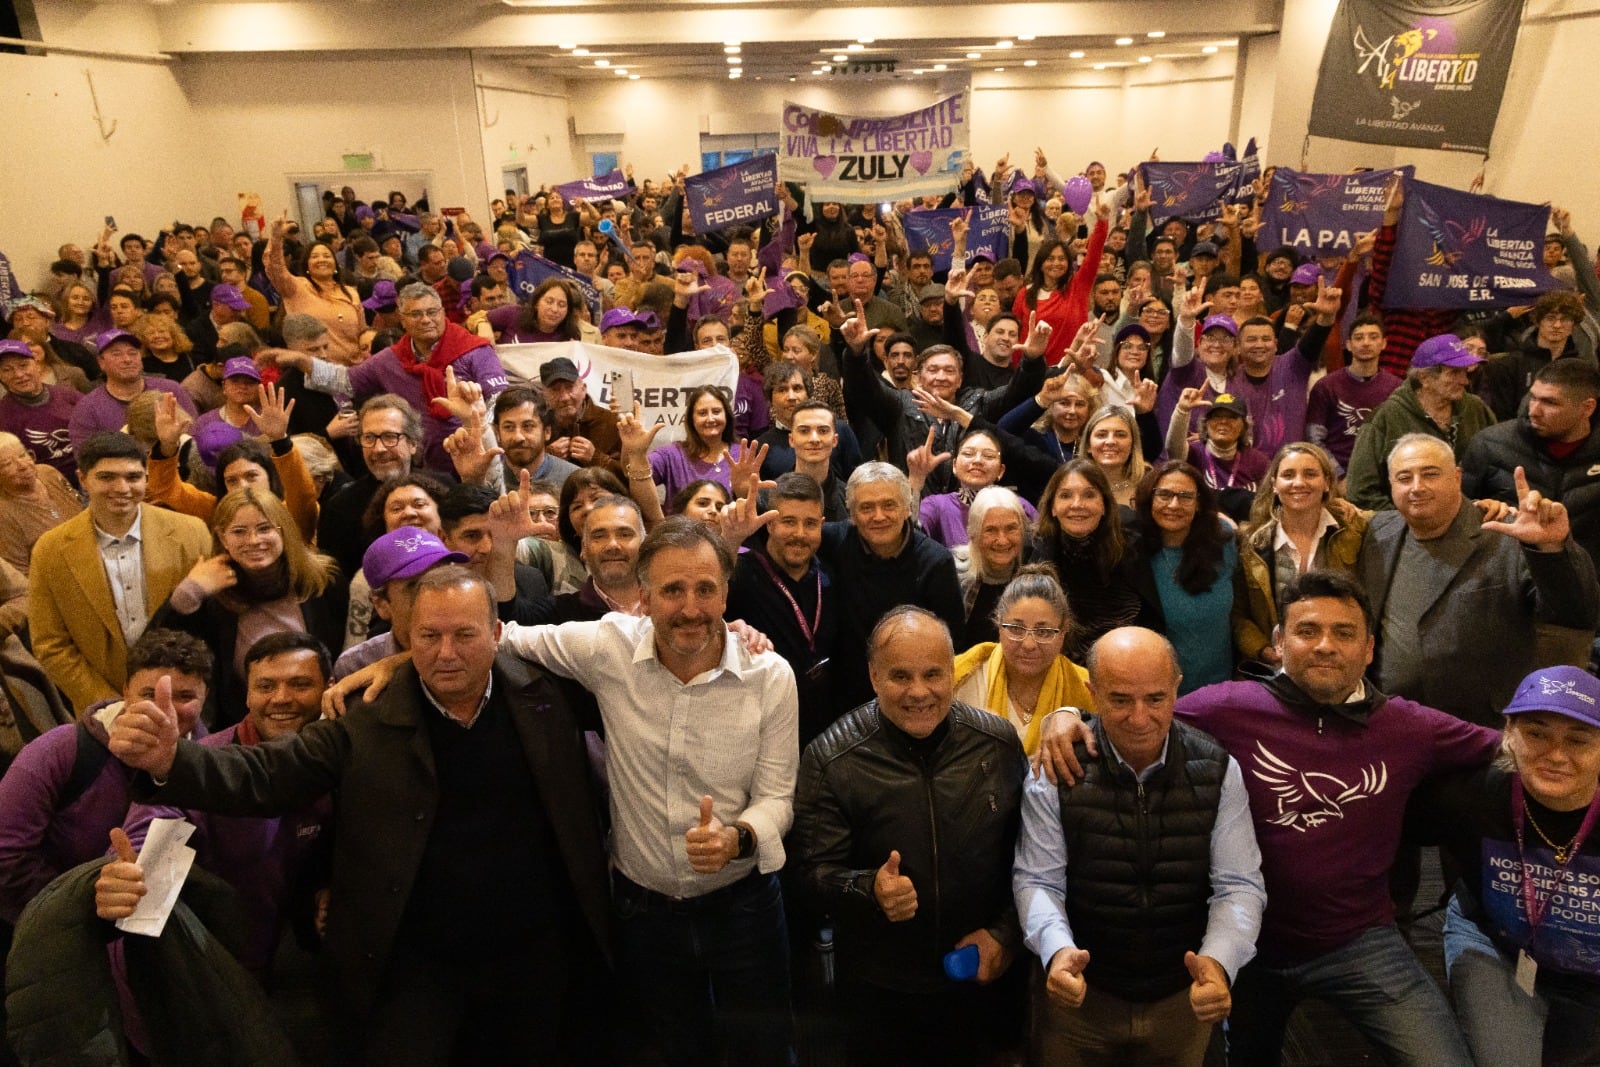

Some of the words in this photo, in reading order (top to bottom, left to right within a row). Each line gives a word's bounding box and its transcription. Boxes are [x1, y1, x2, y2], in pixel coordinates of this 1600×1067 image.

[1368, 119, 1409, 131] LIBERTAD
[1409, 122, 1446, 132] AVANZA
[787, 135, 819, 158] VIVA
[863, 126, 953, 152] LIBERTAD
[838, 154, 910, 181] ZULY
[1346, 177, 1359, 185] LA
[1343, 186, 1386, 195] LIBERT
[705, 200, 773, 226] FEDERAL
[1342, 203, 1370, 211] ENTRE
[1372, 204, 1387, 212] RIO
[1282, 227, 1311, 248] LA
[1486, 227, 1498, 238] LA
[1486, 238, 1535, 251] LIBERTAD
[1419, 272, 1441, 287] SAN
[1446, 274, 1469, 288] JOSE
[1473, 275, 1489, 288] DE
[1469, 289, 1495, 301] E.R.
[602, 373, 612, 385] L
[599, 385, 734, 408] LBERTD
[655, 413, 687, 426] AVA
[1490, 856, 1575, 882] NOSOTROS
[1498, 871, 1588, 897] OUSIDERS
